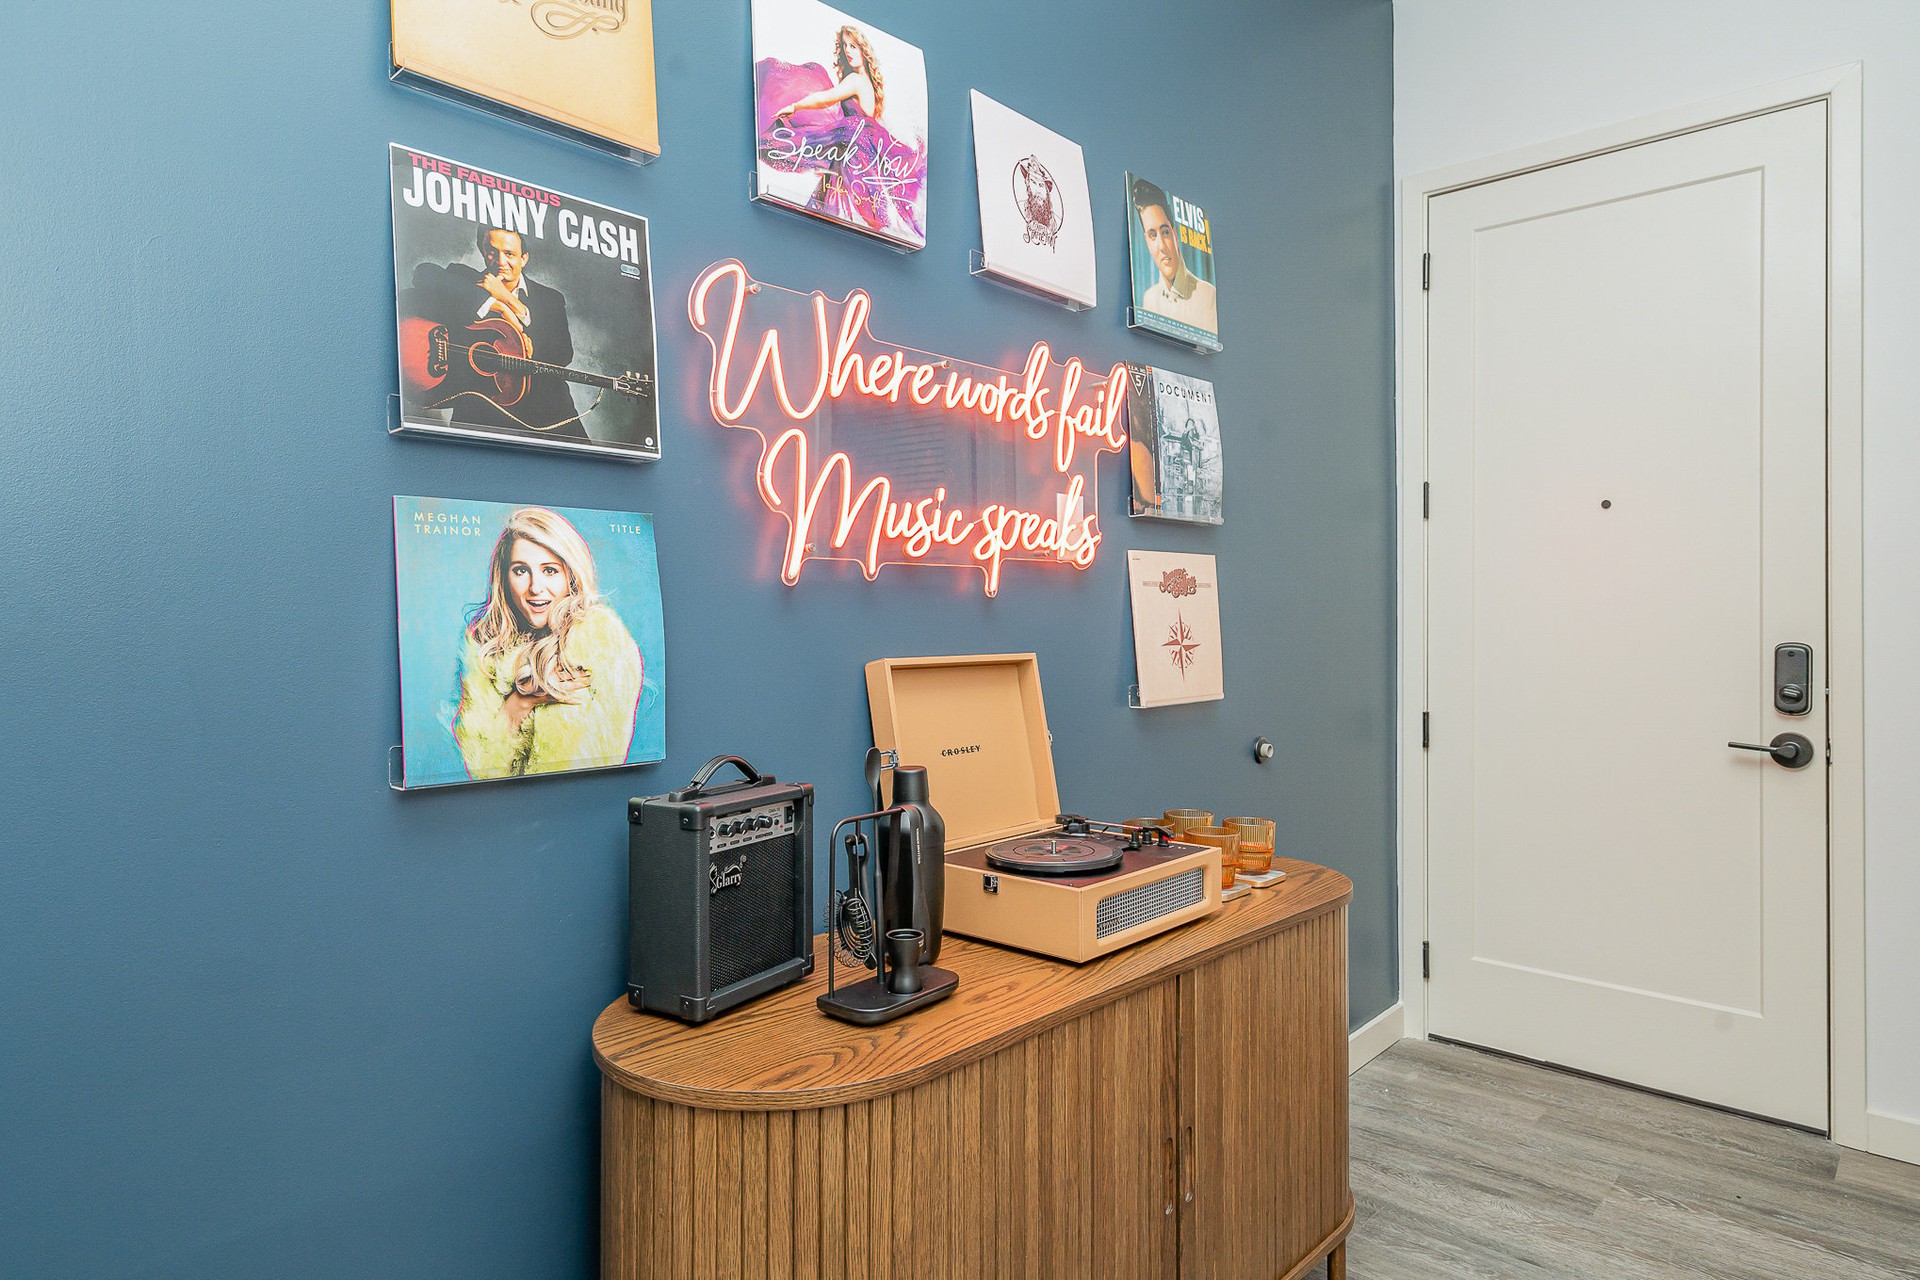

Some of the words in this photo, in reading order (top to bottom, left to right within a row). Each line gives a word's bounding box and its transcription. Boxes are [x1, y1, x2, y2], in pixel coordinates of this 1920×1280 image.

[767, 118, 864, 172] Speak
[853, 134, 919, 180] Now
[408, 152, 452, 177] THE
[457, 166, 562, 207] FABULOUS
[402, 166, 549, 240] JOHNNY
[558, 208, 640, 265] CASH
[1172, 195, 1206, 235] ELVIS
[1179, 224, 1188, 245] IS
[696, 262, 940, 421] Where
[946, 340, 1055, 441] words
[1053, 358, 1128, 474] fail
[1135, 374, 1142, 388] 5
[1159, 381, 1212, 405] DOCUMENT
[414, 511, 481, 525] MEGHAN
[762, 428, 974, 580] Music
[972, 473, 1101, 596] speaks
[414, 523, 481, 537] TRAINOR
[610, 523, 641, 535] TITLE
[941, 744, 981, 757] CROSLEY
[716, 871, 743, 889] Glarry
